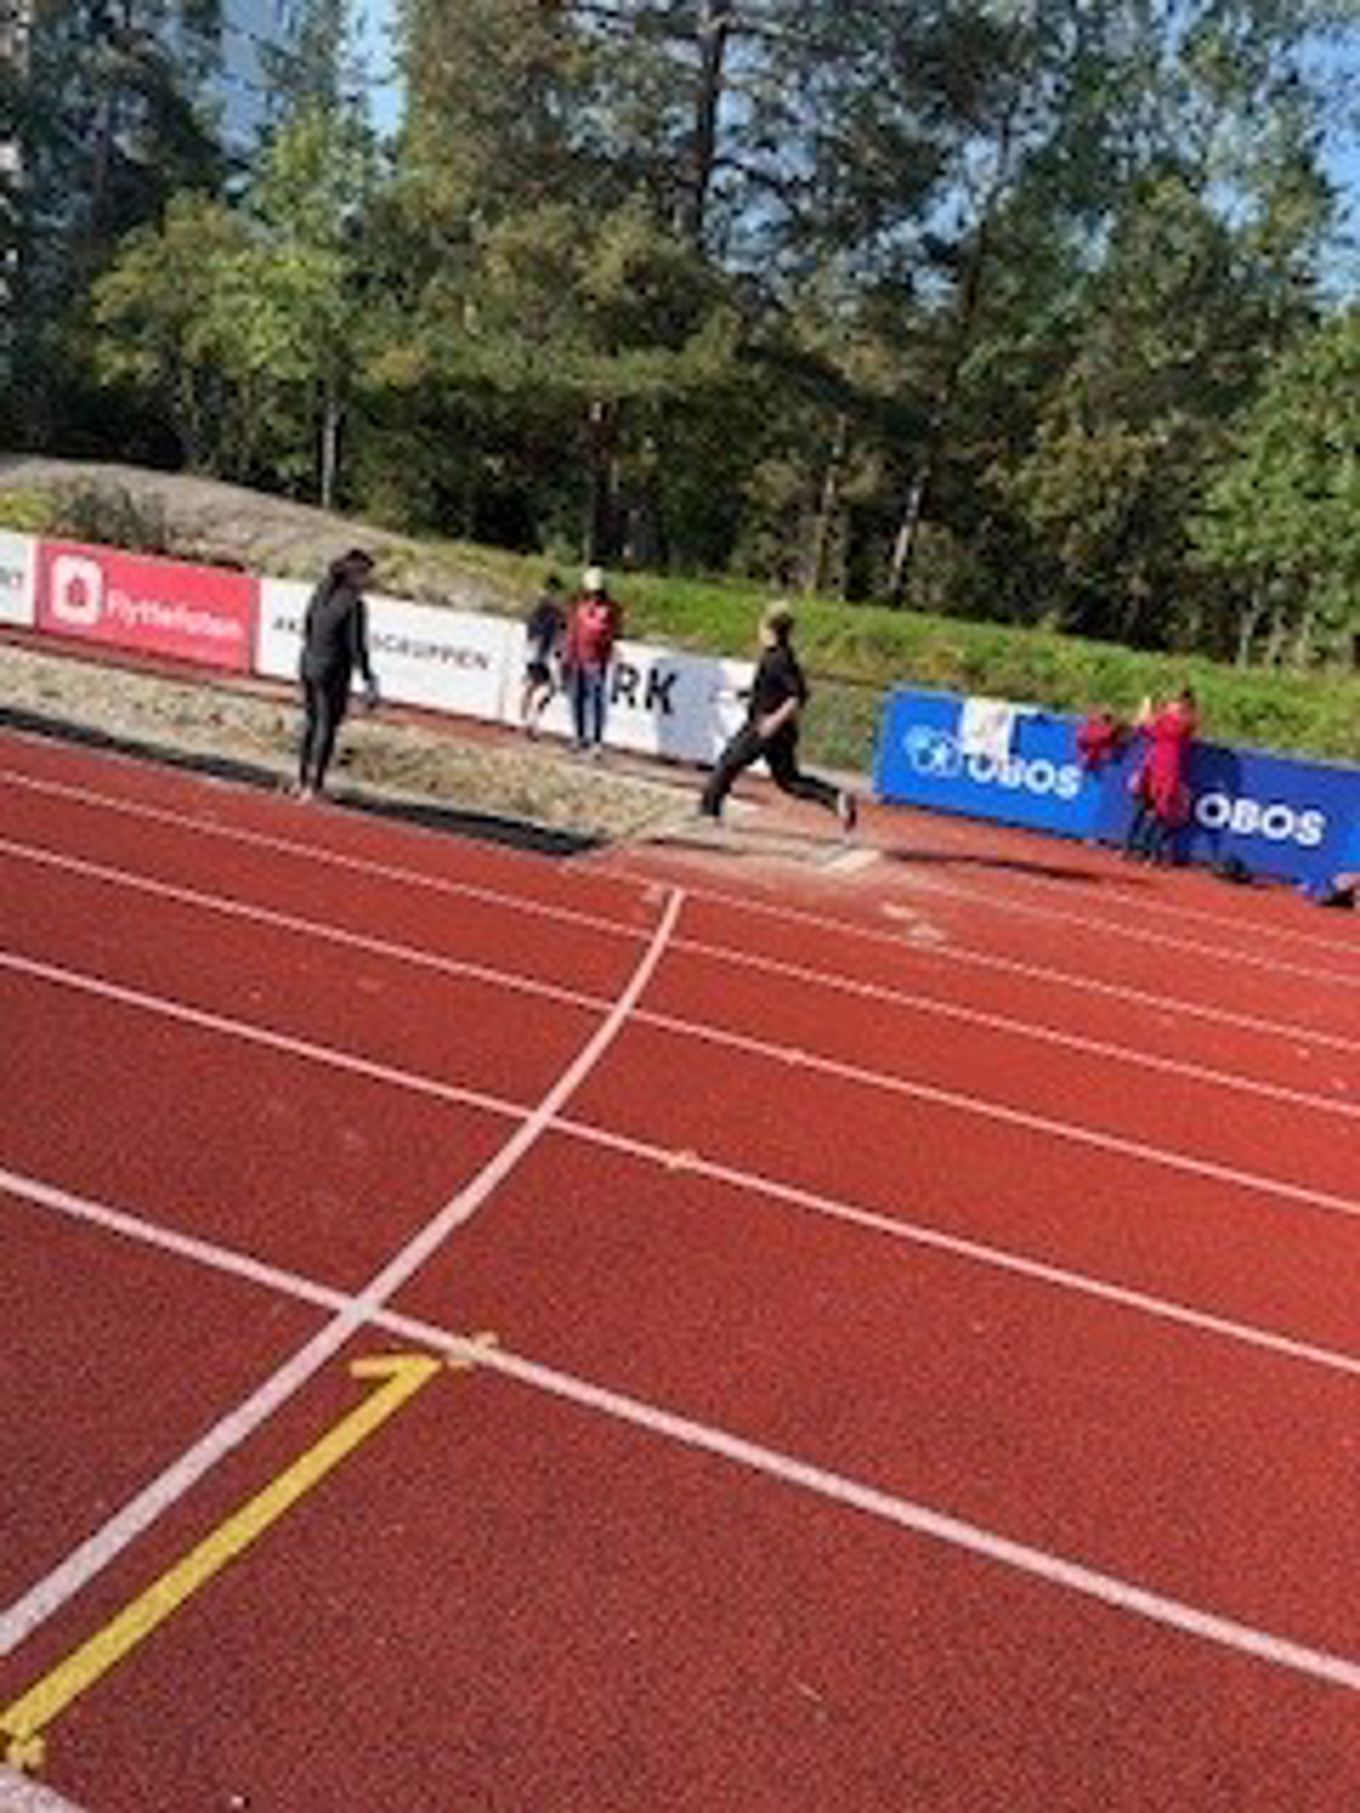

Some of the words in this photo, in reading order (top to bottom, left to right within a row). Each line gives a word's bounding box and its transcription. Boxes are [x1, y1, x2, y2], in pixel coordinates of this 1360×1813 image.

[610, 663, 676, 714] RK
[967, 749, 1080, 800] OBOS
[1197, 792, 1326, 846] OBOS
